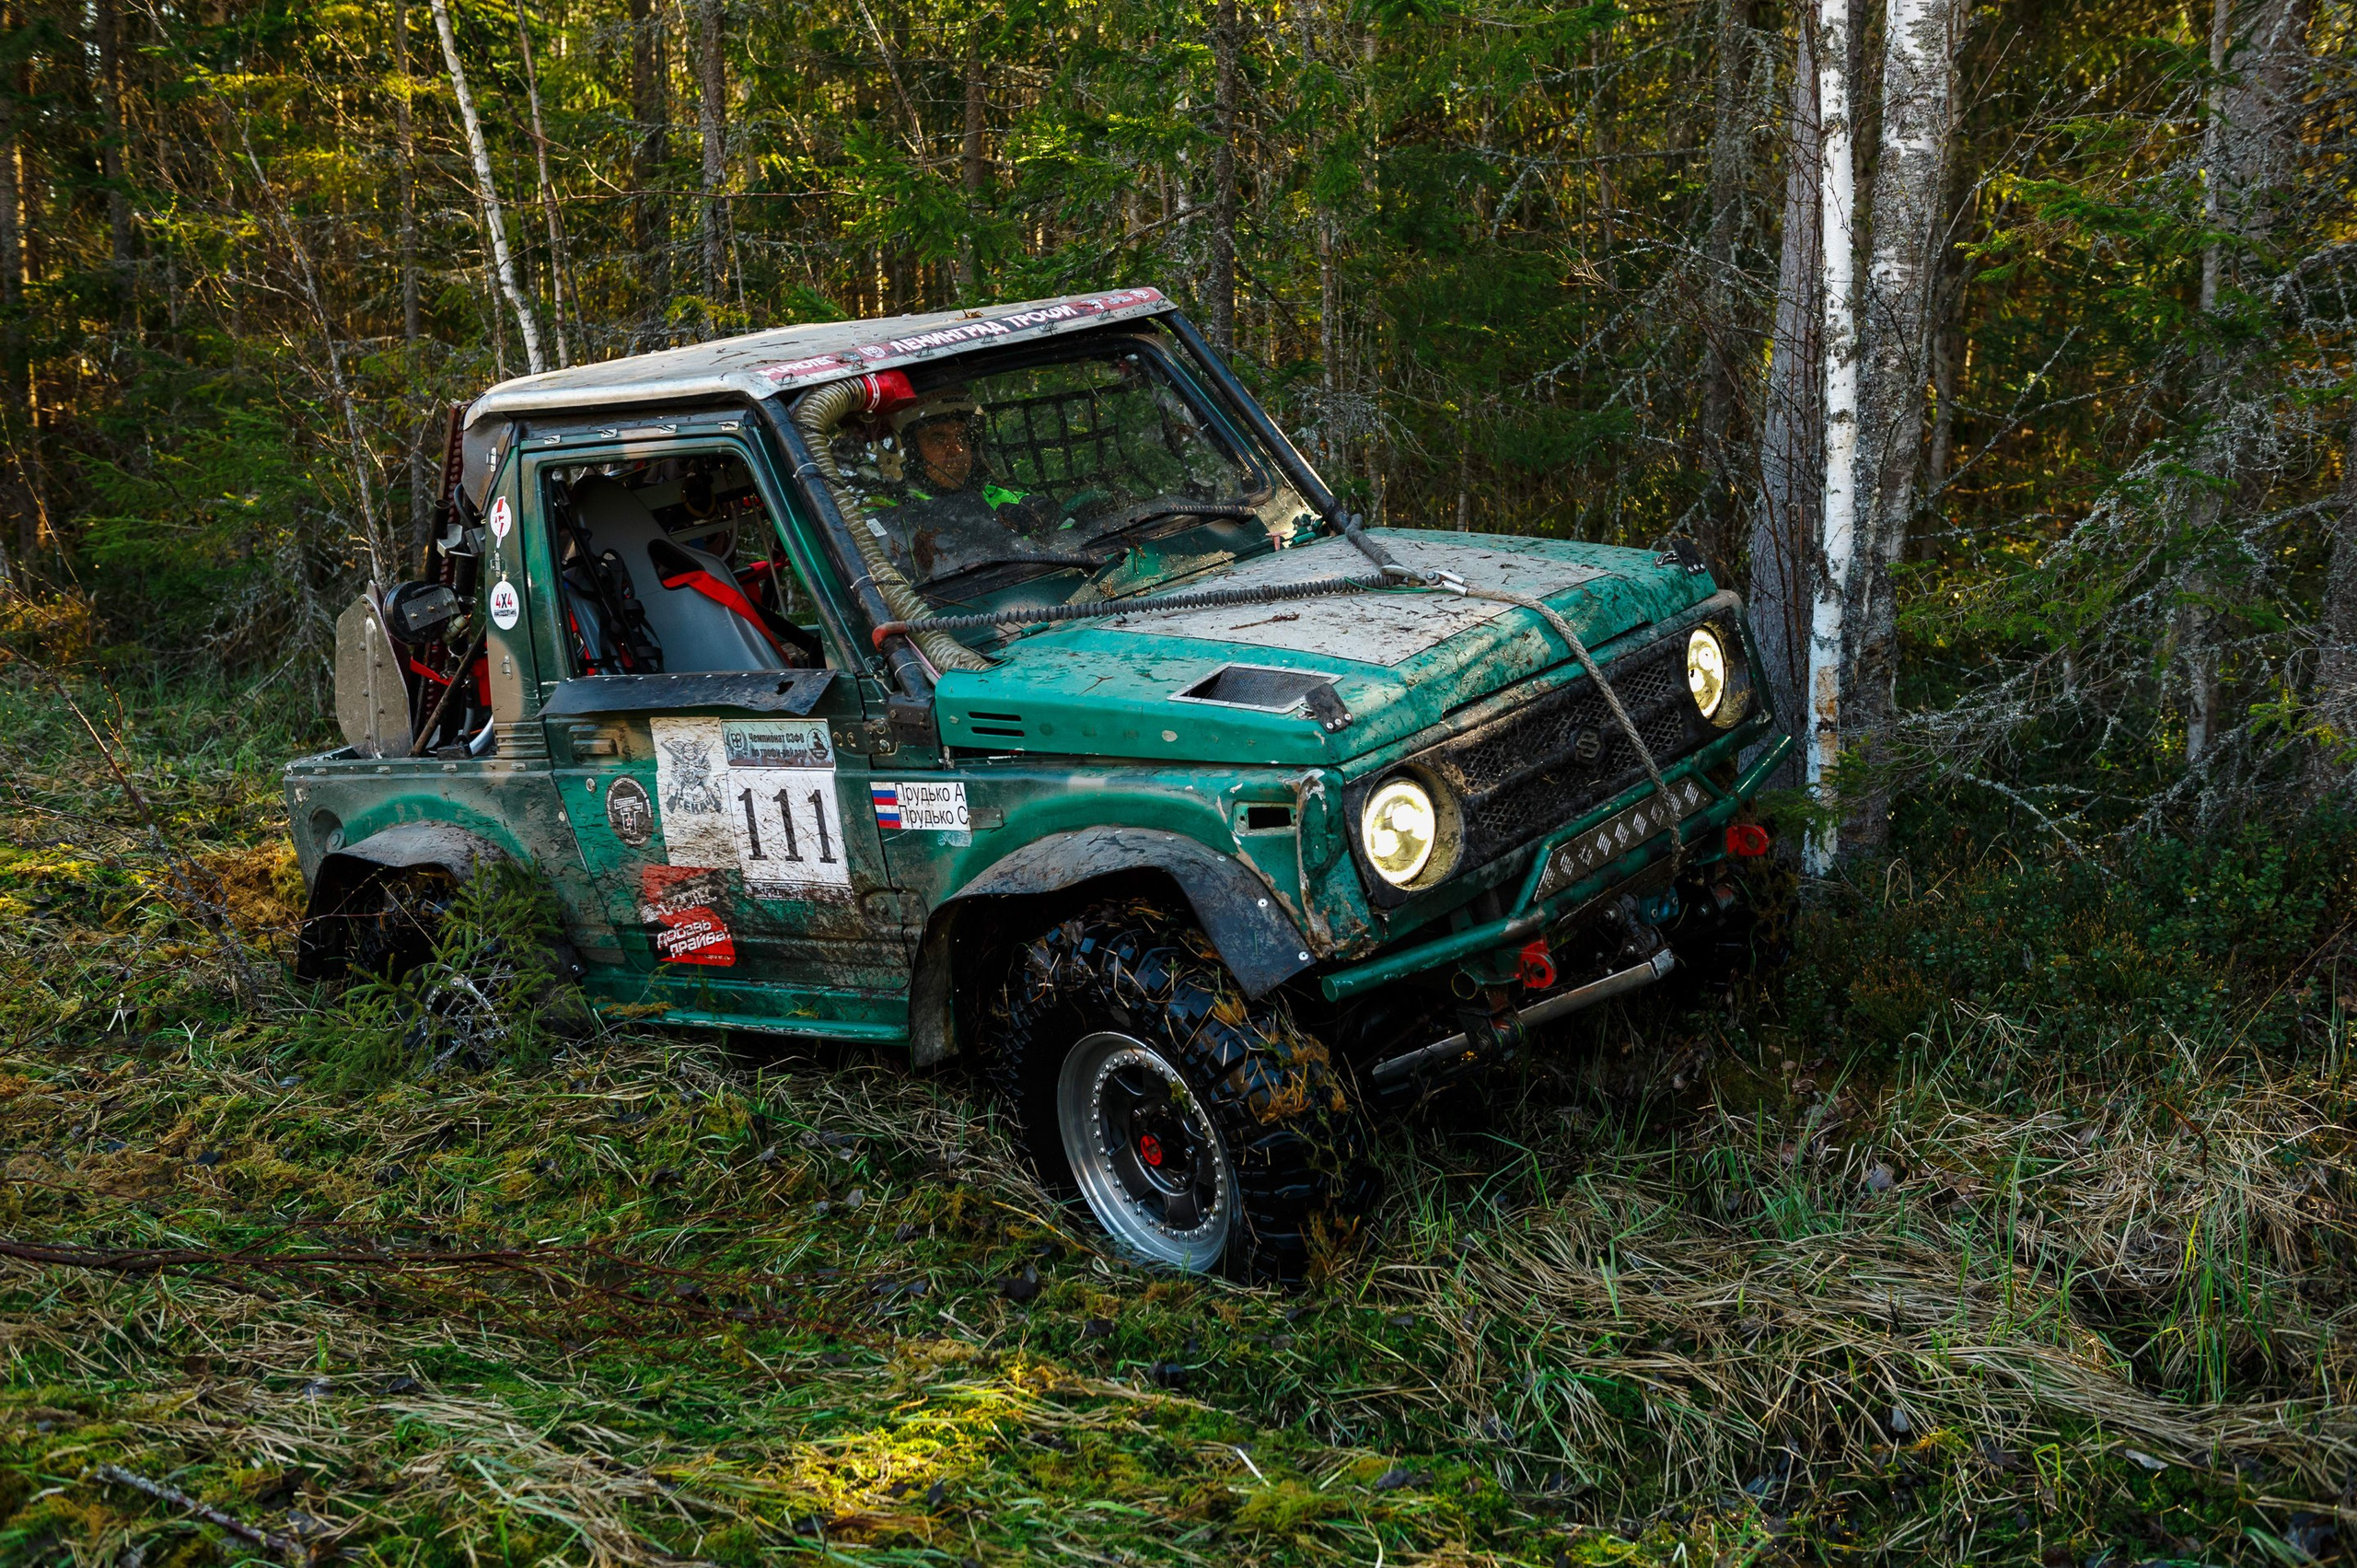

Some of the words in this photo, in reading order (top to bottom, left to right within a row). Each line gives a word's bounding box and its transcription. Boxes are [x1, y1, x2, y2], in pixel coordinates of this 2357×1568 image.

[889, 320, 1010, 353] ЛЕНИНГРАД
[1001, 304, 1078, 328] ТРОФИ
[749, 733, 785, 743] Чемпионат
[785, 733, 805, 743] СЗФО
[895, 783, 950, 807] Прудько
[955, 783, 966, 802] А
[737, 788, 838, 864] 111
[899, 805, 954, 829] Прудько
[958, 806, 970, 825] С
